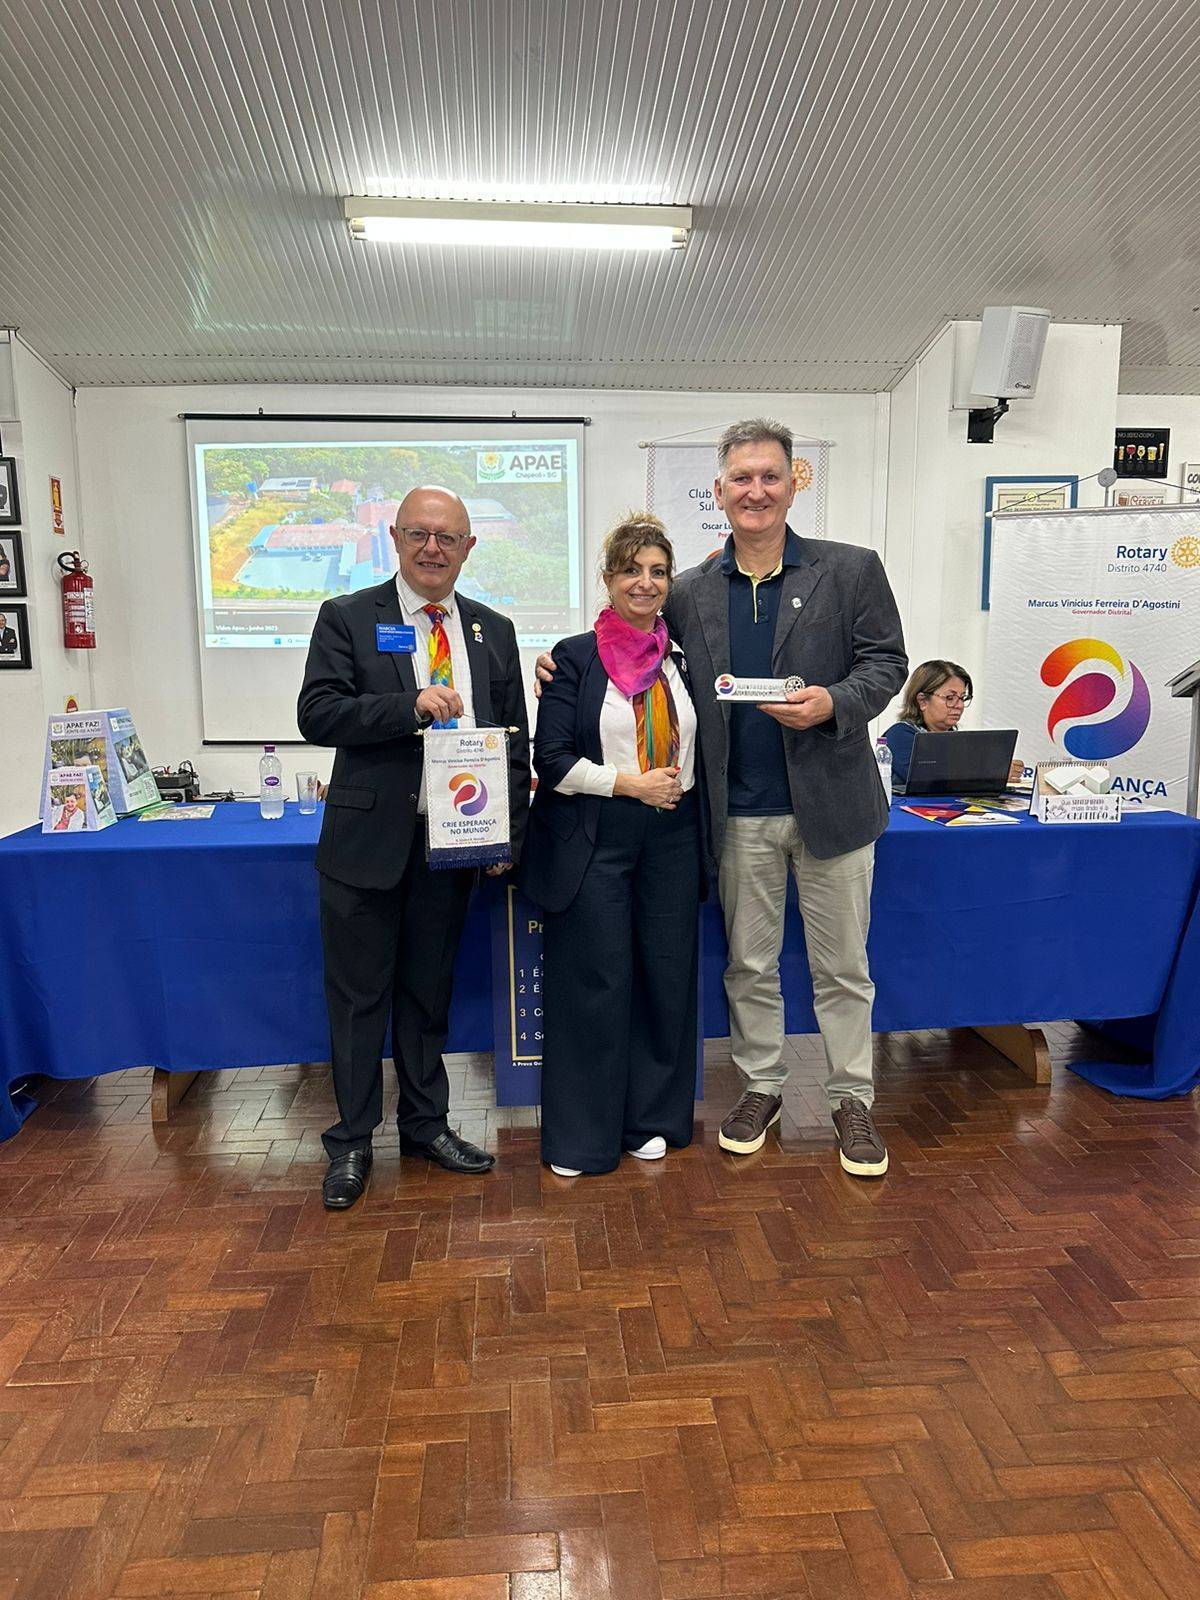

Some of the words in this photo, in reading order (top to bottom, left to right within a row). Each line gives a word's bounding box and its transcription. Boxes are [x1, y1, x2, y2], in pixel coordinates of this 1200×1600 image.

[509, 454, 562, 471] APAE
[1187, 473, 1200, 484] CO
[688, 488, 712, 499] Club
[699, 501, 714, 511] Sul
[701, 522, 722, 530] Oscar
[724, 522, 732, 530] Lu
[1116, 545, 1168, 561] Rotary
[1107, 563, 1140, 573] Distrito
[1142, 563, 1167, 573] 4740
[1028, 599, 1058, 608] Marcus
[1060, 599, 1093, 608] Vinicius
[1095, 599, 1130, 608] Ferreira
[1132, 600, 1181, 610] D'Agostini
[66, 721, 84, 729] APAE
[85, 720, 99, 728] FAZ!
[460, 739, 484, 747] Rotary
[1110, 776, 1168, 798] ANÇA
[459, 819, 497, 827] ESPERANÇA
[462, 826, 490, 834] MUNDO
[519, 968, 524, 977] 1
[519, 984, 525, 993] 2
[520, 1008, 526, 1017] 3
[520, 1032, 527, 1040] 4
